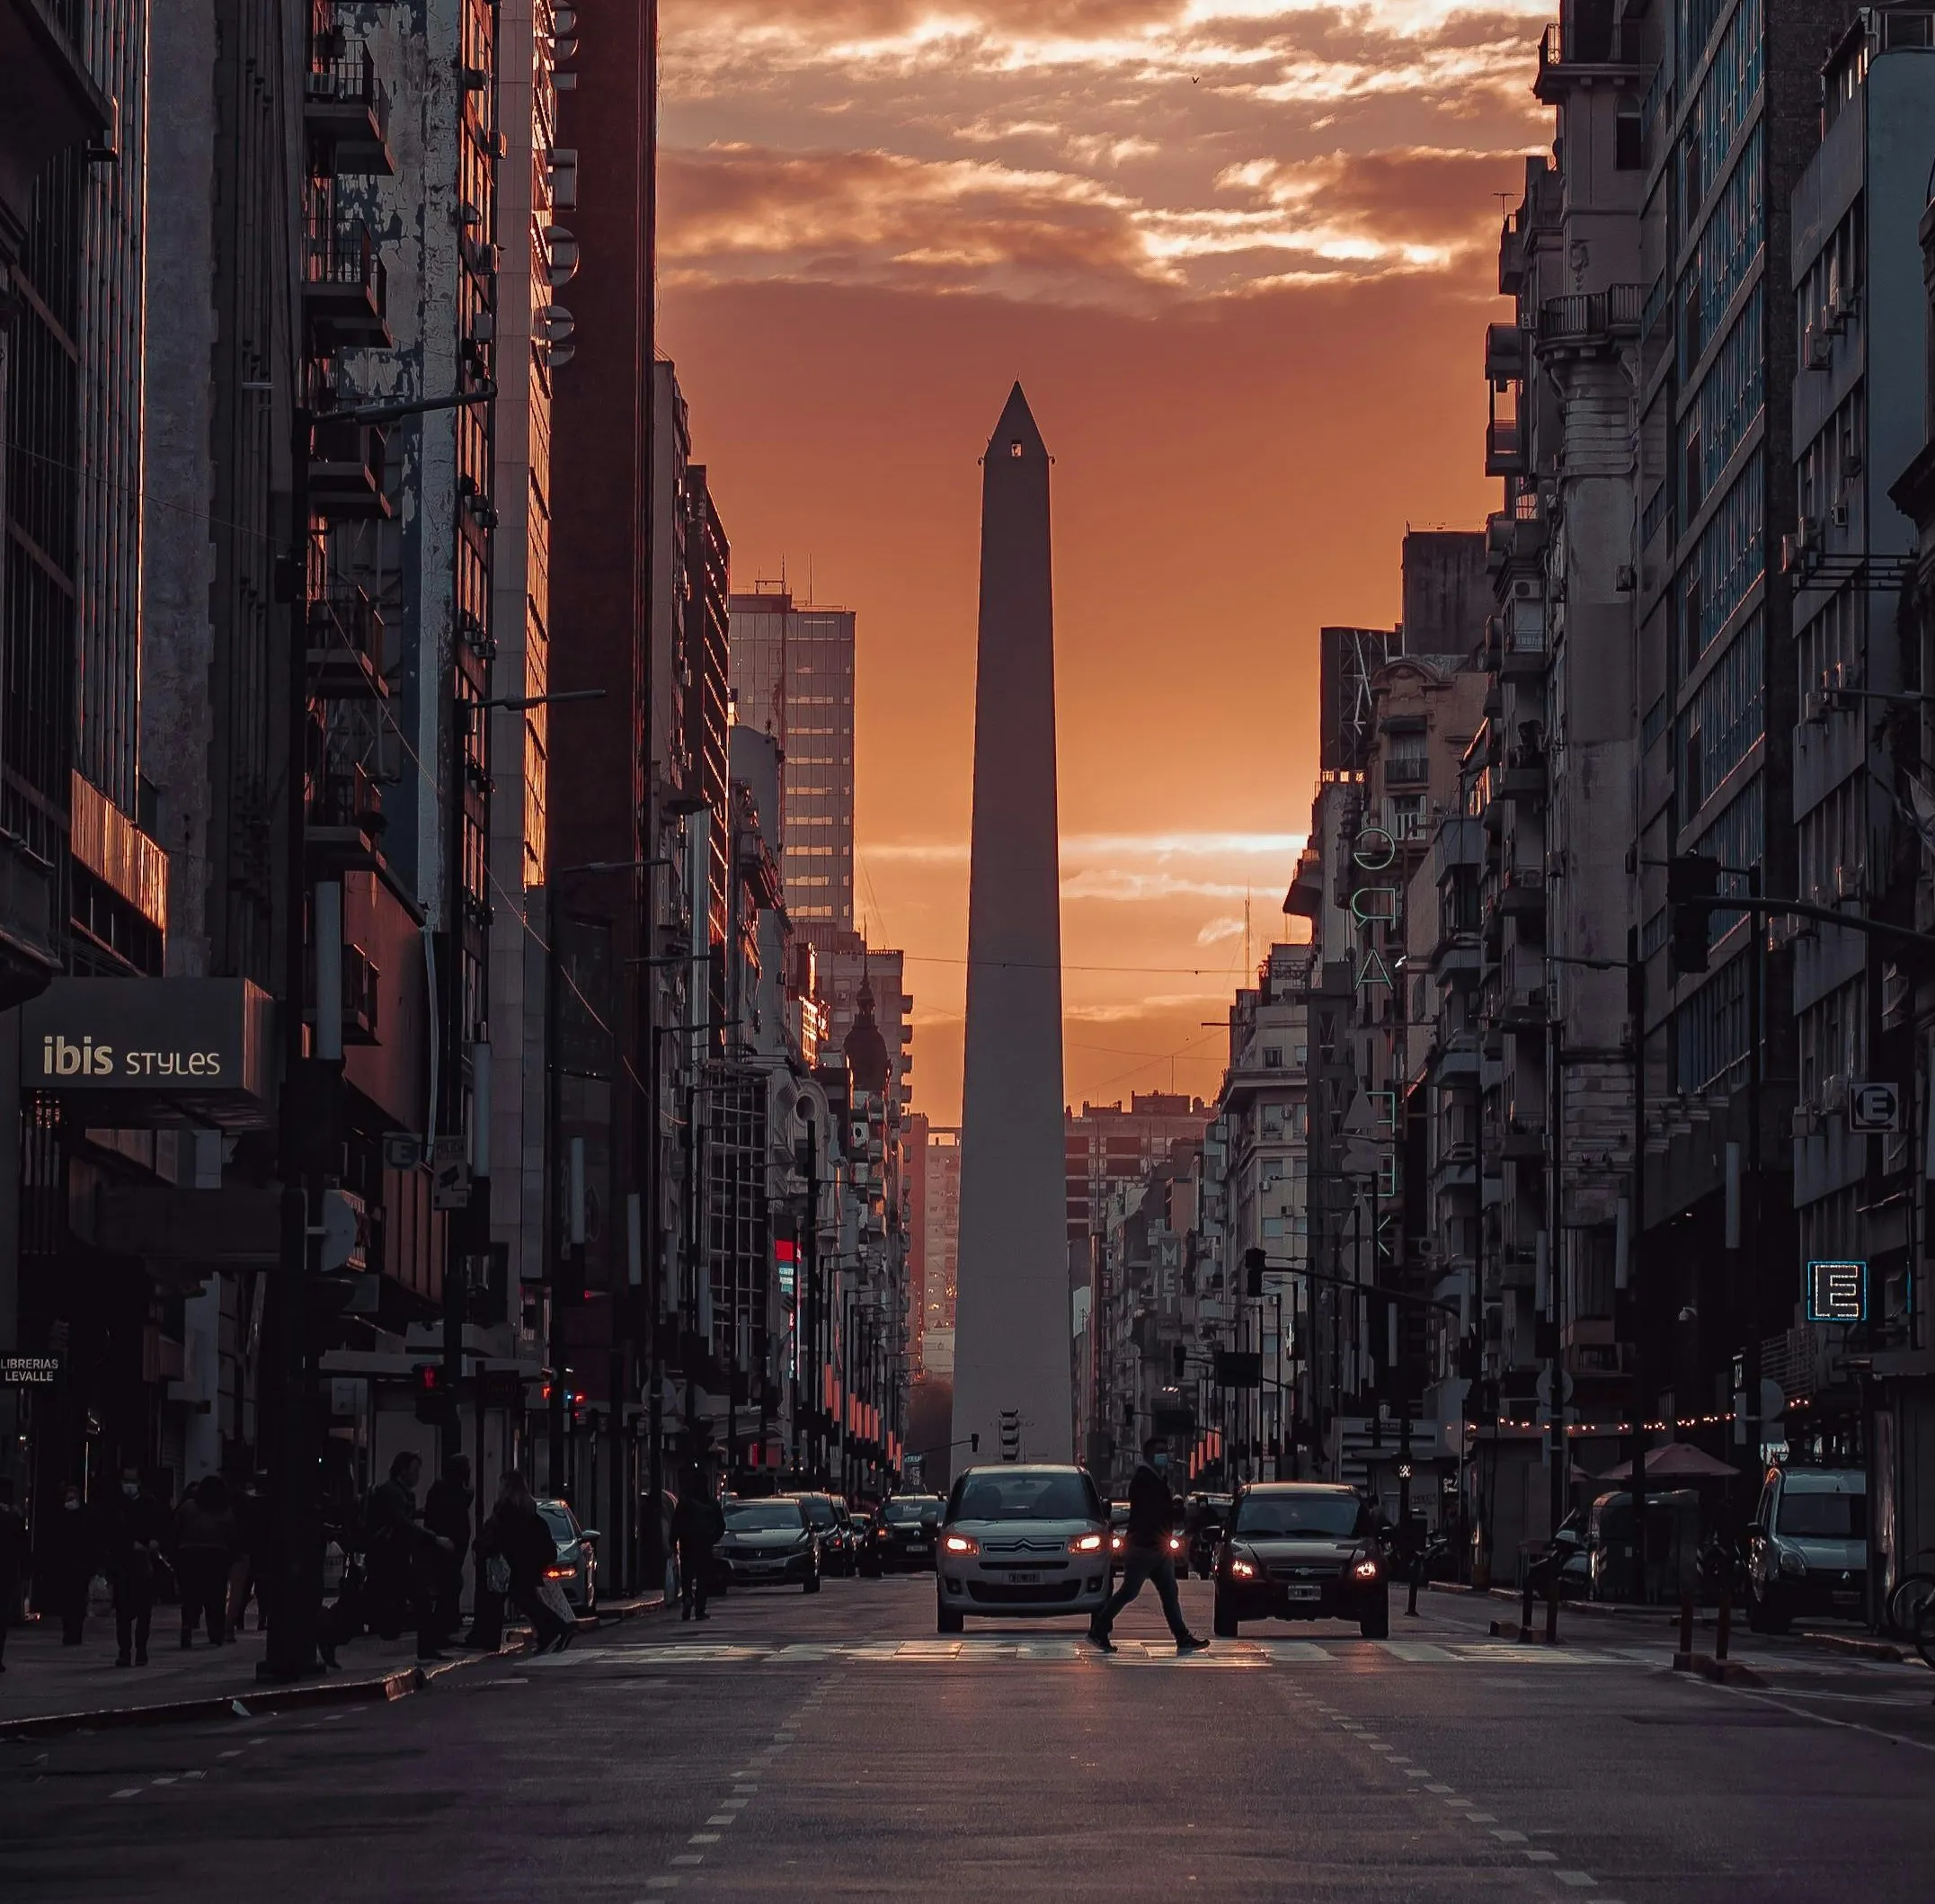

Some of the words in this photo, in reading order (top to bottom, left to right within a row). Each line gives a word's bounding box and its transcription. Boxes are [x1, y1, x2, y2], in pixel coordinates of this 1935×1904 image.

[43, 1035, 113, 1075] ibis
[1863, 1090, 1890, 1121] E
[1161, 1241, 1178, 1314] MET
[1815, 1264, 1859, 1317] E
[0, 1358, 58, 1369] LIBRERIAS
[5, 1371, 54, 1382] LEVALLE
